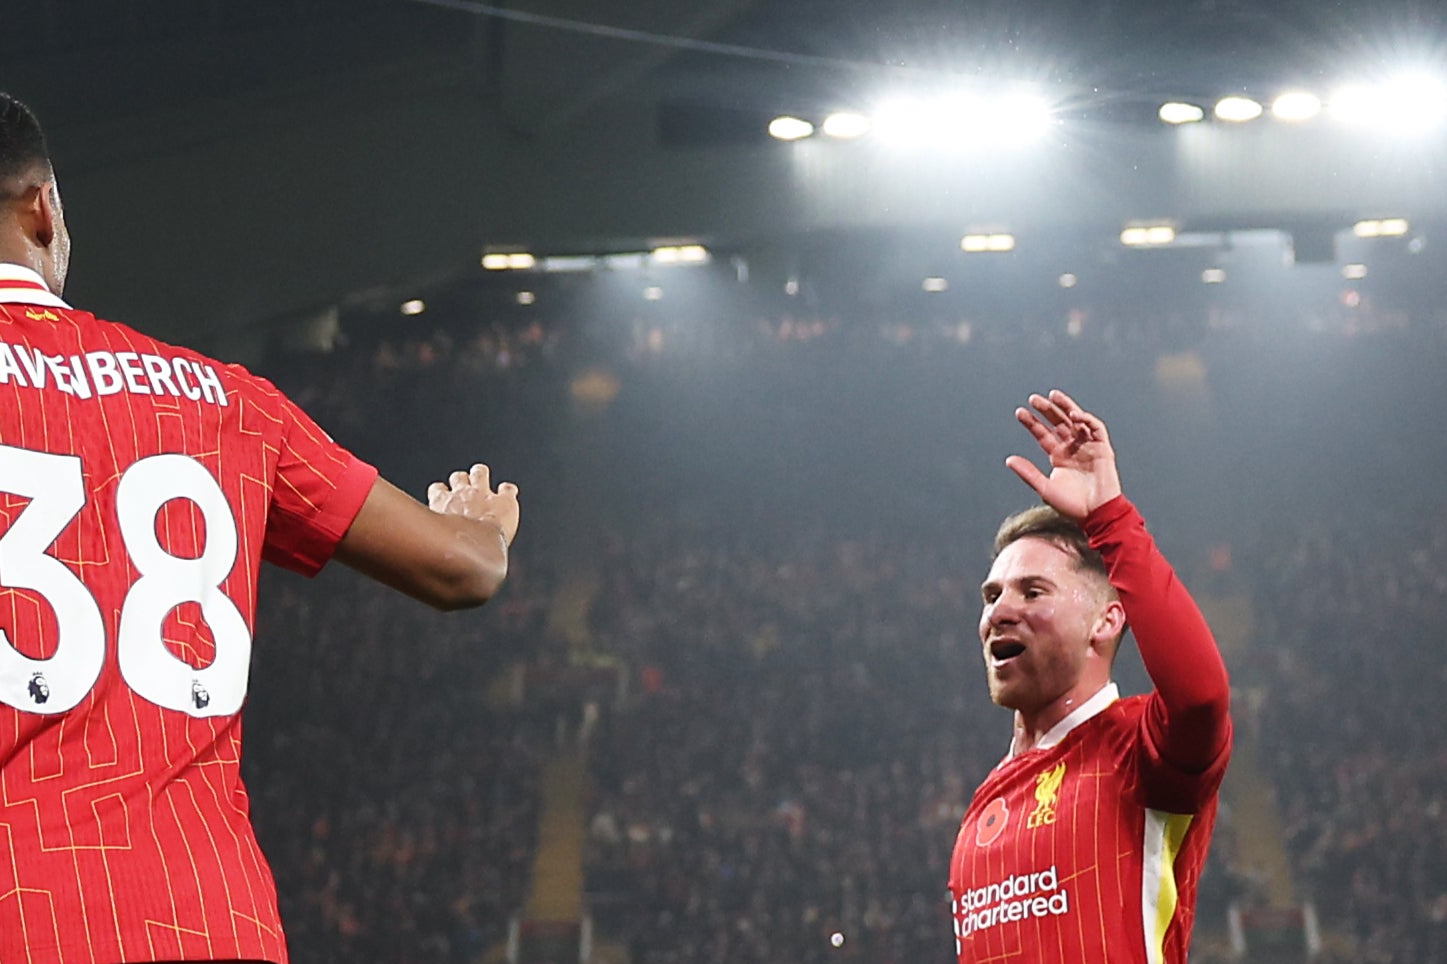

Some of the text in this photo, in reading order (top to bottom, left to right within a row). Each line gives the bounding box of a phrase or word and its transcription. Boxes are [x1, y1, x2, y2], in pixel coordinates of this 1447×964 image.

[1027, 809, 1057, 830] LFC
[960, 865, 1058, 915] standard
[961, 889, 1069, 938] chartered
